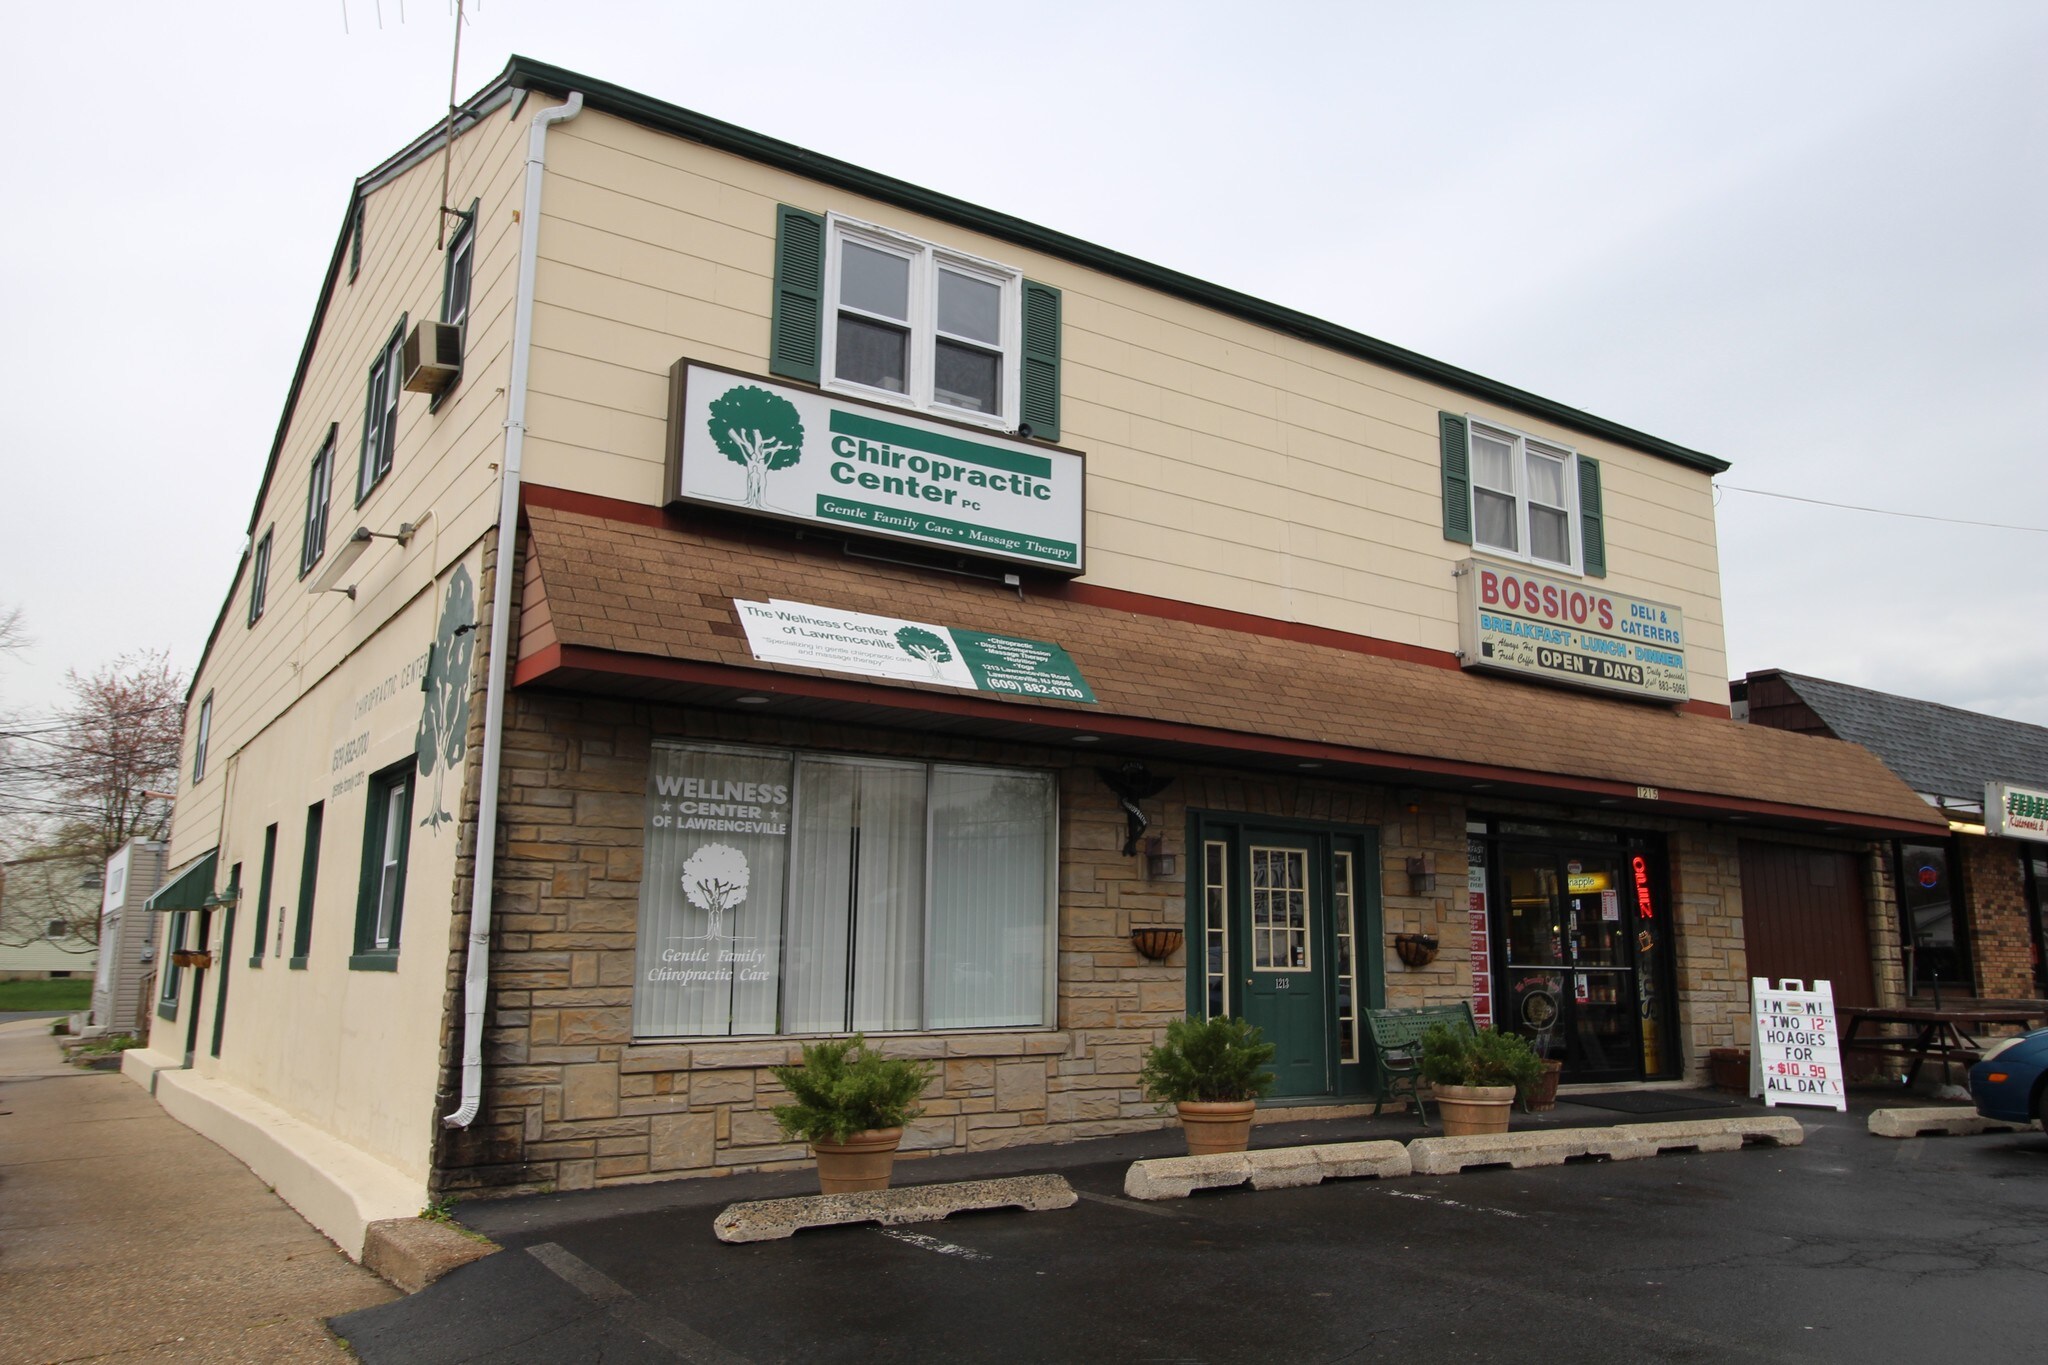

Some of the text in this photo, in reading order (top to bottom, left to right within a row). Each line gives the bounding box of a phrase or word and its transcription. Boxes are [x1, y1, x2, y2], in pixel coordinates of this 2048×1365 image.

[830, 435, 1052, 501] Chiropractic
[830, 461, 981, 512] Center PC
[823, 501, 1072, 560] Gentle Family Care Massage Therapy
[1480, 570, 1614, 630] BOSSIO'S
[743, 606, 888, 637] The Wellness Center
[1630, 603, 1667, 624] DELI &
[782, 626, 895, 650] of Lawrenceville
[1620, 619, 1680, 644] CATERERS
[997, 644, 1051, 657] Decompression
[1480, 614, 1683, 669] BREAKFAST LUNCH DINNER
[1497, 637, 1534, 652] Always Hot
[815, 651, 851, 662] massage
[825, 646, 849, 654] gentle
[850, 649, 894, 661] chiropractic
[987, 648, 1048, 662] Massage Therapy
[1006, 657, 1037, 665] Nutrition
[1498, 649, 1535, 667] Fresh Coffee
[1000, 666, 1050, 678] Lawrenceville
[1050, 673, 1071, 681] Road
[1015, 663, 1035, 671] Yoga
[1540, 649, 1641, 683] OPEN 7 DAYS
[1646, 665, 1685, 682] Daily Specials
[987, 671, 1040, 683] Lawrenceville,
[354, 653, 428, 721] CHIROPRACTIC CENTER
[987, 677, 1084, 699] (609) 882-0700
[655, 774, 788, 805] WELLNESS
[1638, 787, 1658, 799] 1215
[679, 801, 761, 819] CENTER
[652, 815, 787, 835] OF LAWRENCEVILLE
[662, 948, 766, 968] Gentle Family
[648, 967, 770, 986] Chiropractic Care
[1275, 977, 1290, 990] 1213
[1770, 1015, 1800, 1029] TWO
[1767, 1030, 1826, 1046] HOAGIES
[1785, 1047, 1813, 1061] FOR
[1777, 1062, 1826, 1079] $10.99
[1768, 1077, 1792, 1091] ALL
[1798, 1079, 1825, 1093] DAY
